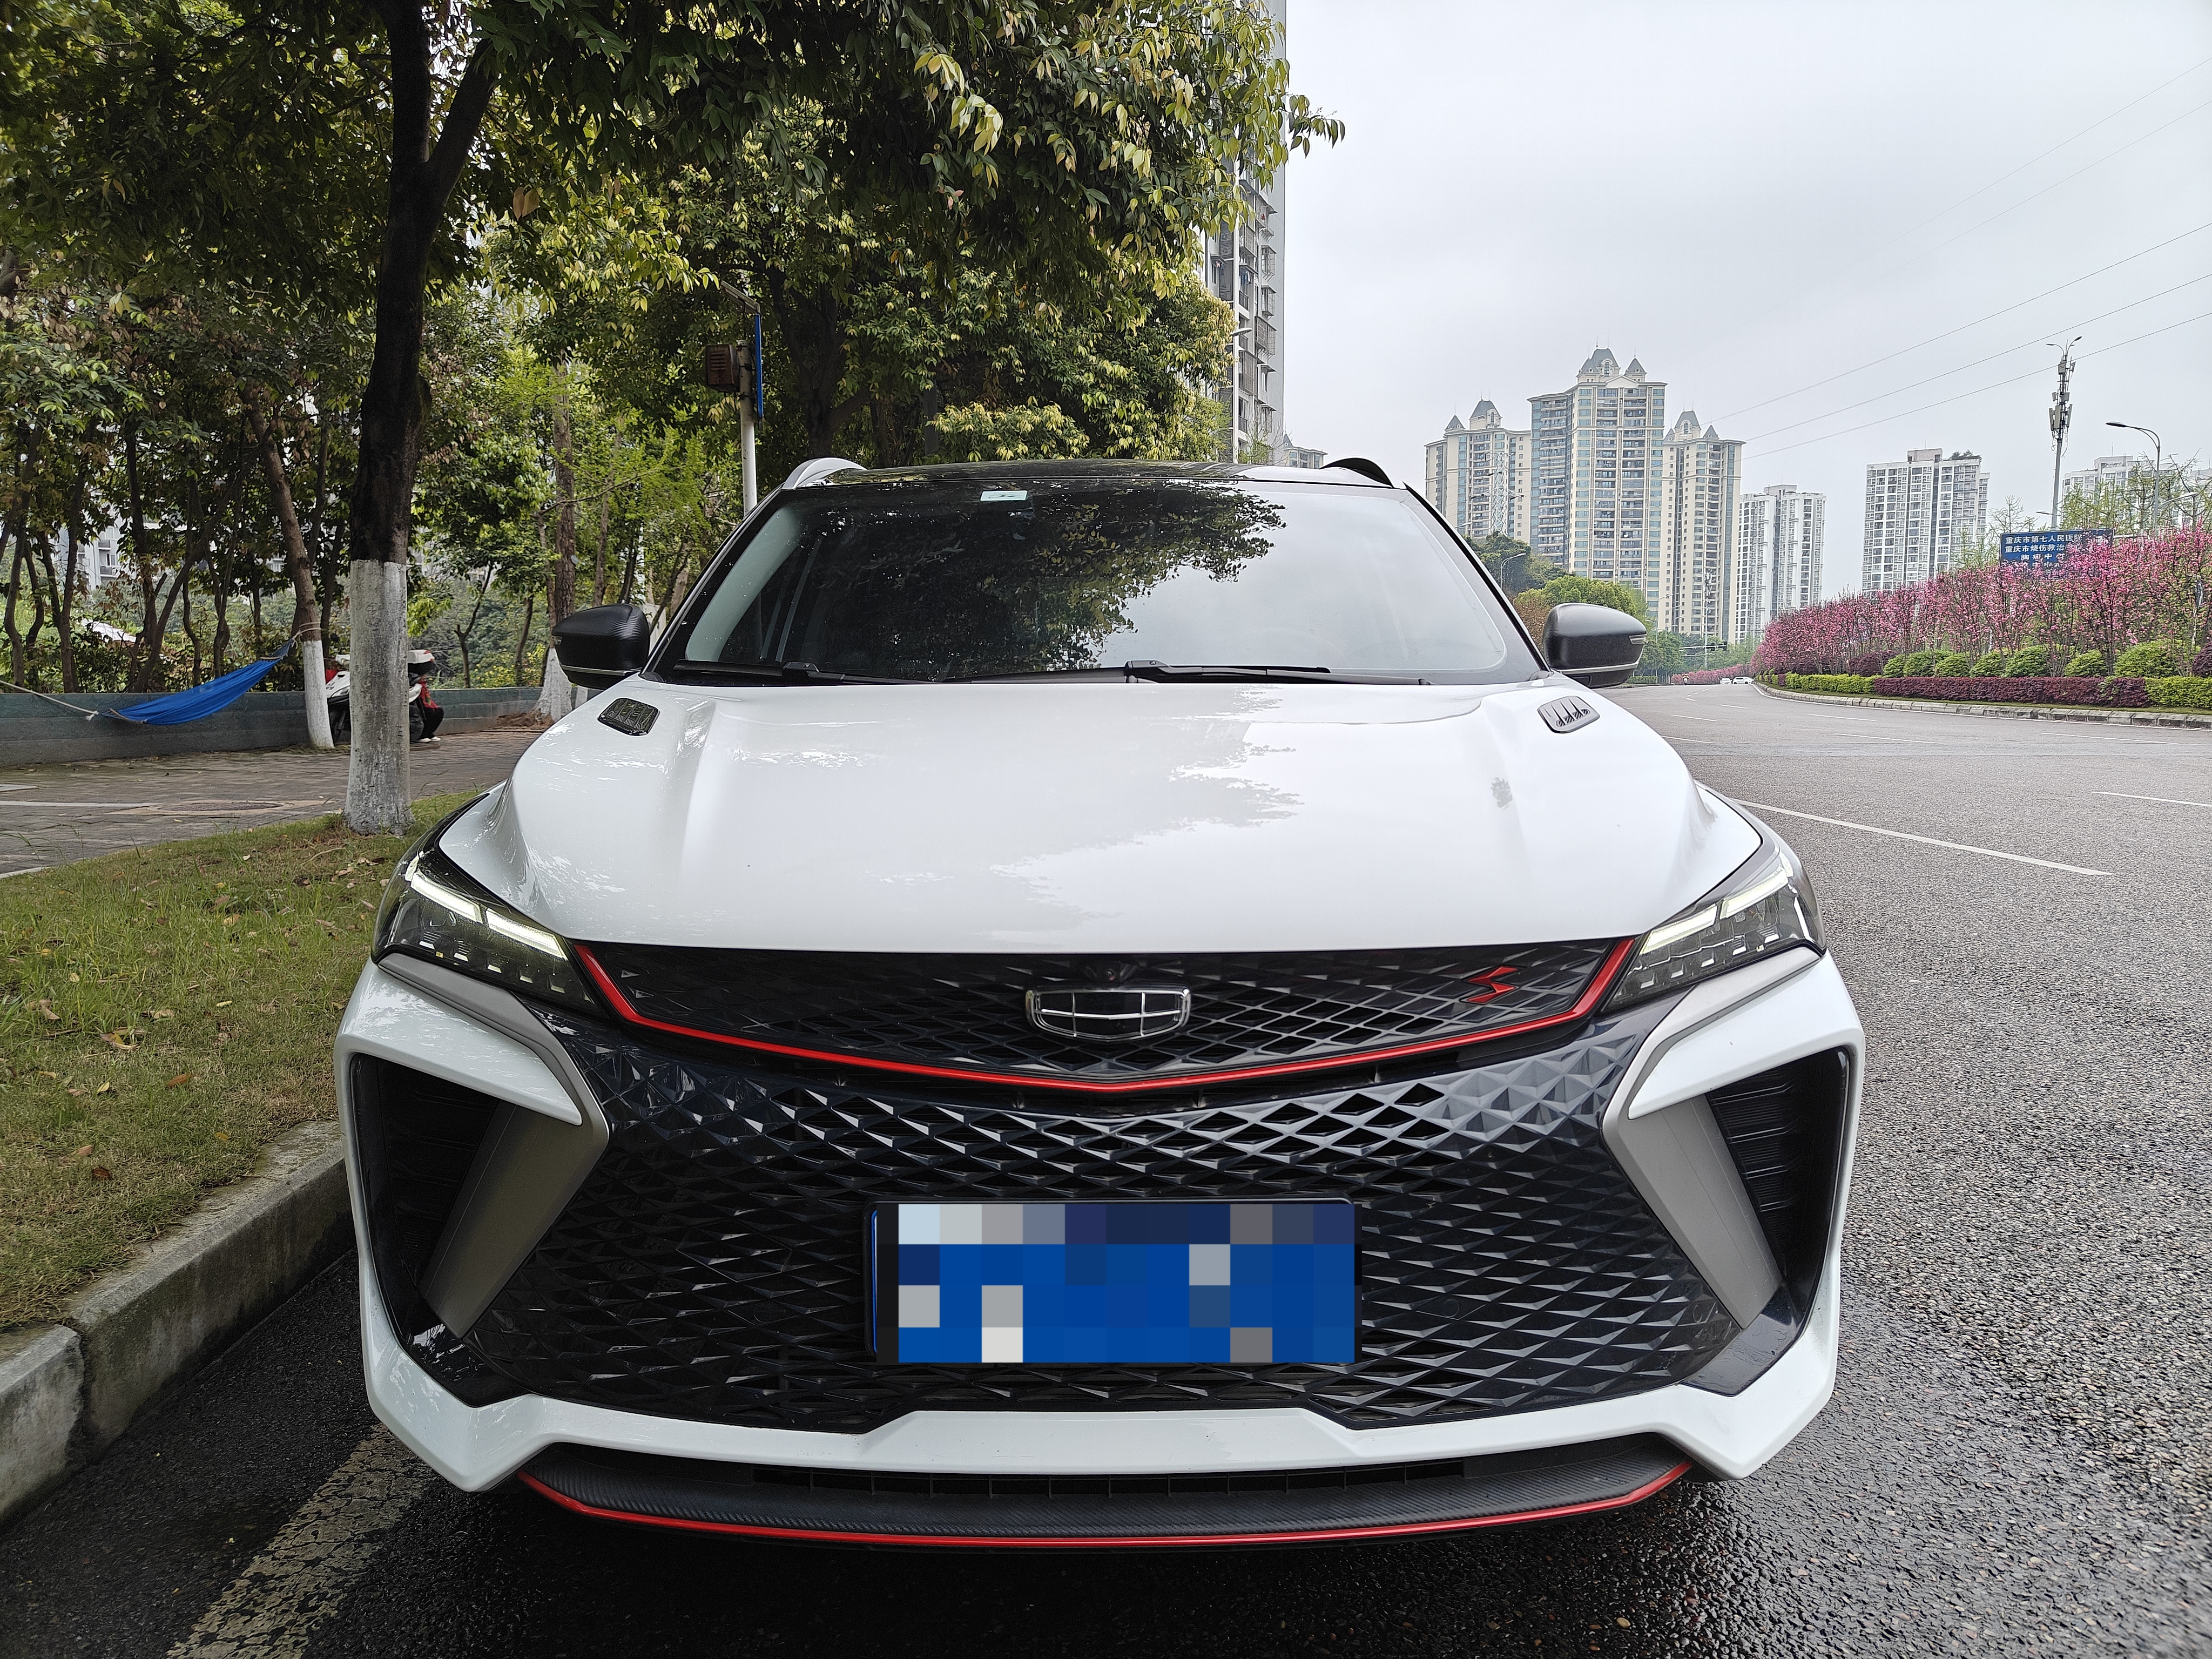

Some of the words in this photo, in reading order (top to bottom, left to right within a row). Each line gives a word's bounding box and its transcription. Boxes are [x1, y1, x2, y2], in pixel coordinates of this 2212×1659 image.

[2005, 534, 2082, 544] 重庆市第七人民医院
[2005, 543, 2072, 553] 重庆市烧伤救治
